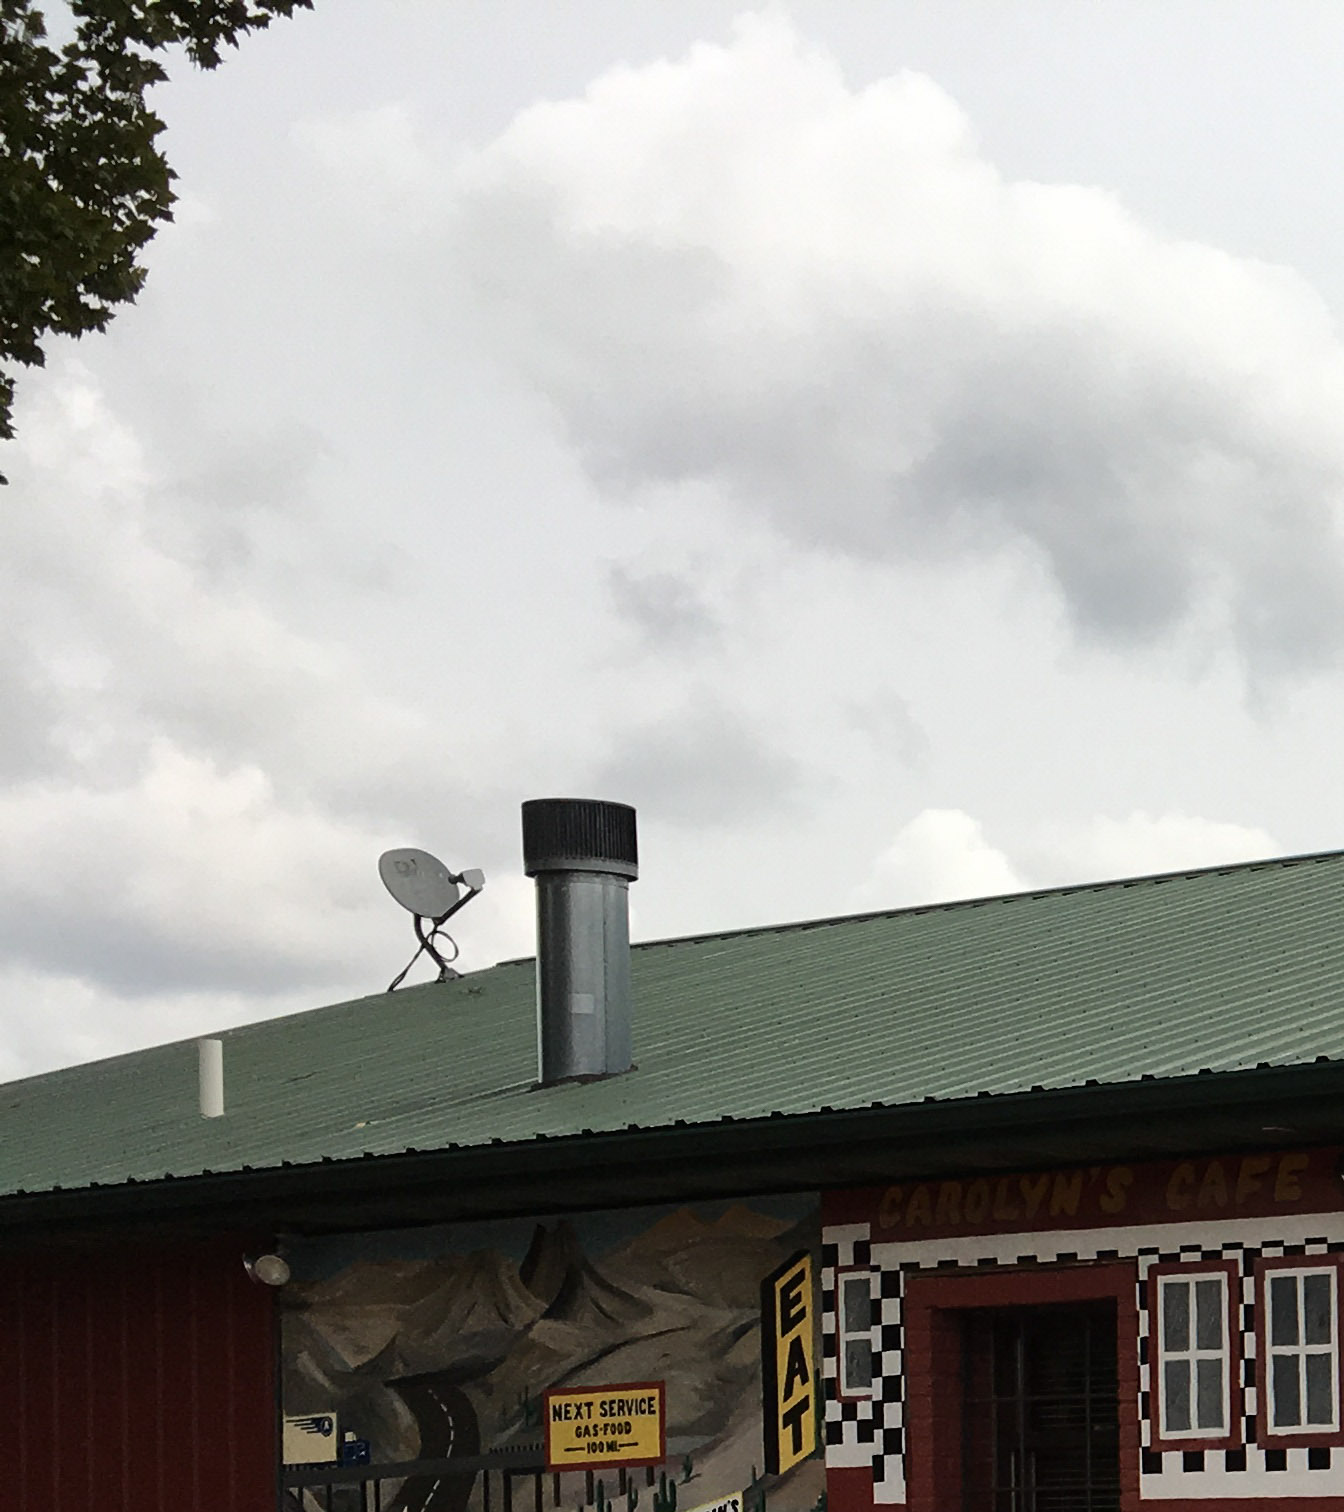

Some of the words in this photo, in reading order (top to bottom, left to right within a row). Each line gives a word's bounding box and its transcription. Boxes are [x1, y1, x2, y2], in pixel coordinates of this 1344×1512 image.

[879, 1165, 1135, 1230] CAROLYN'S
[1166, 1153, 1310, 1211] CAFE
[780, 1268, 810, 1456] EAT
[552, 1401, 594, 1422] NEXT
[599, 1396, 657, 1417] SERVICE
[587, 1440, 604, 1454] 100
